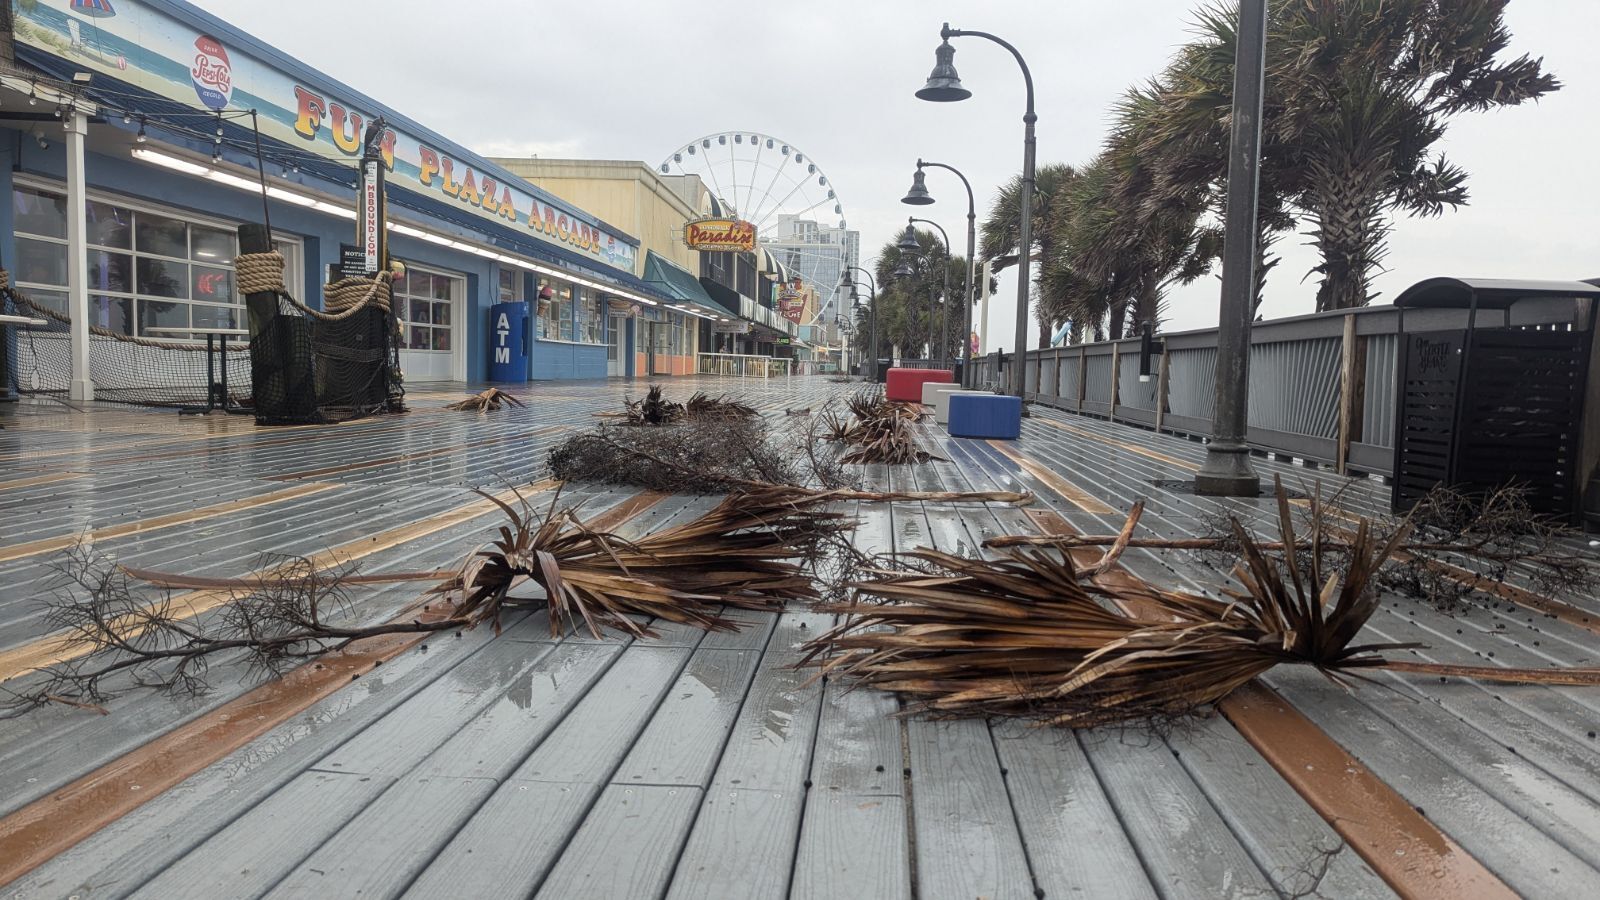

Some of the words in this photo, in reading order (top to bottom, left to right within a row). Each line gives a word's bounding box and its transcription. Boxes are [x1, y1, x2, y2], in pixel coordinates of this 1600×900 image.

[203, 45, 218, 53] DRINK
[418, 145, 516, 222] PLAZA
[528, 199, 601, 255] ARCADE
[690, 224, 753, 246] Paradise
[495, 312, 510, 365] ATM
